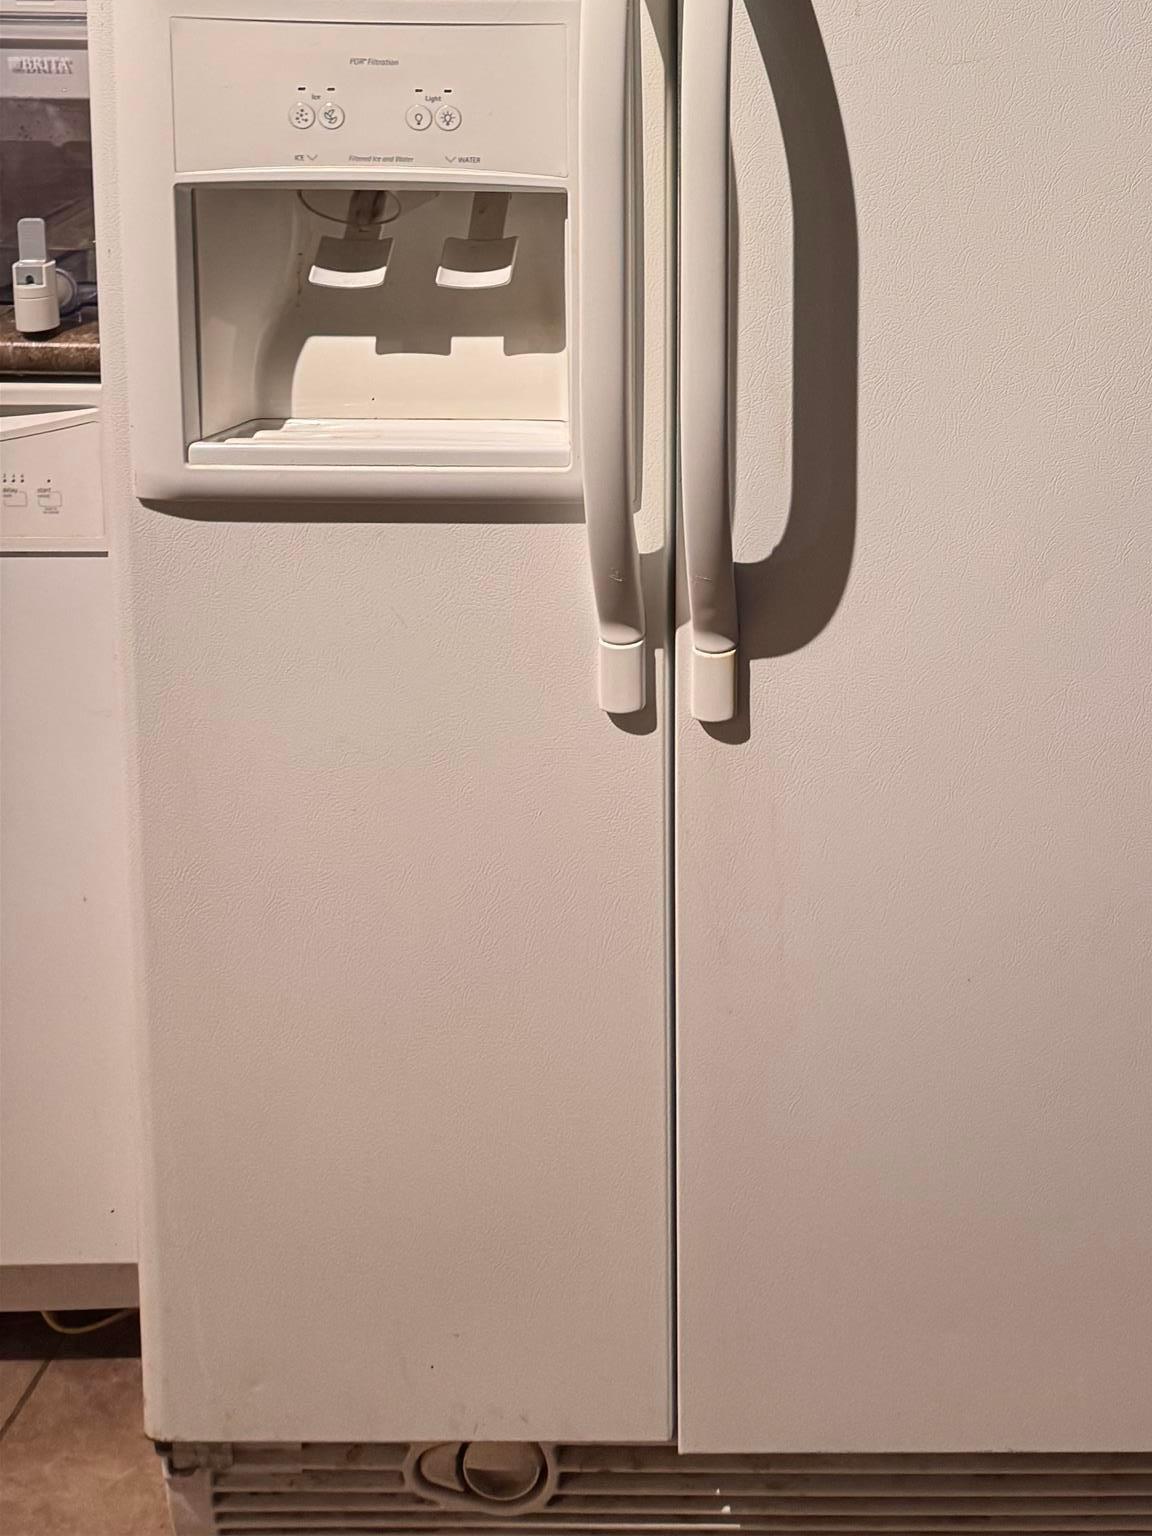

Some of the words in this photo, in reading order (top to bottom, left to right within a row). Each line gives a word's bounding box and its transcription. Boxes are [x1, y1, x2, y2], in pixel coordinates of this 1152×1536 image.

[20, 57, 73, 74] BRITA
[425, 95, 442, 103] Light
[294, 154, 305, 162] ICE
[458, 156, 481, 164] WATER
